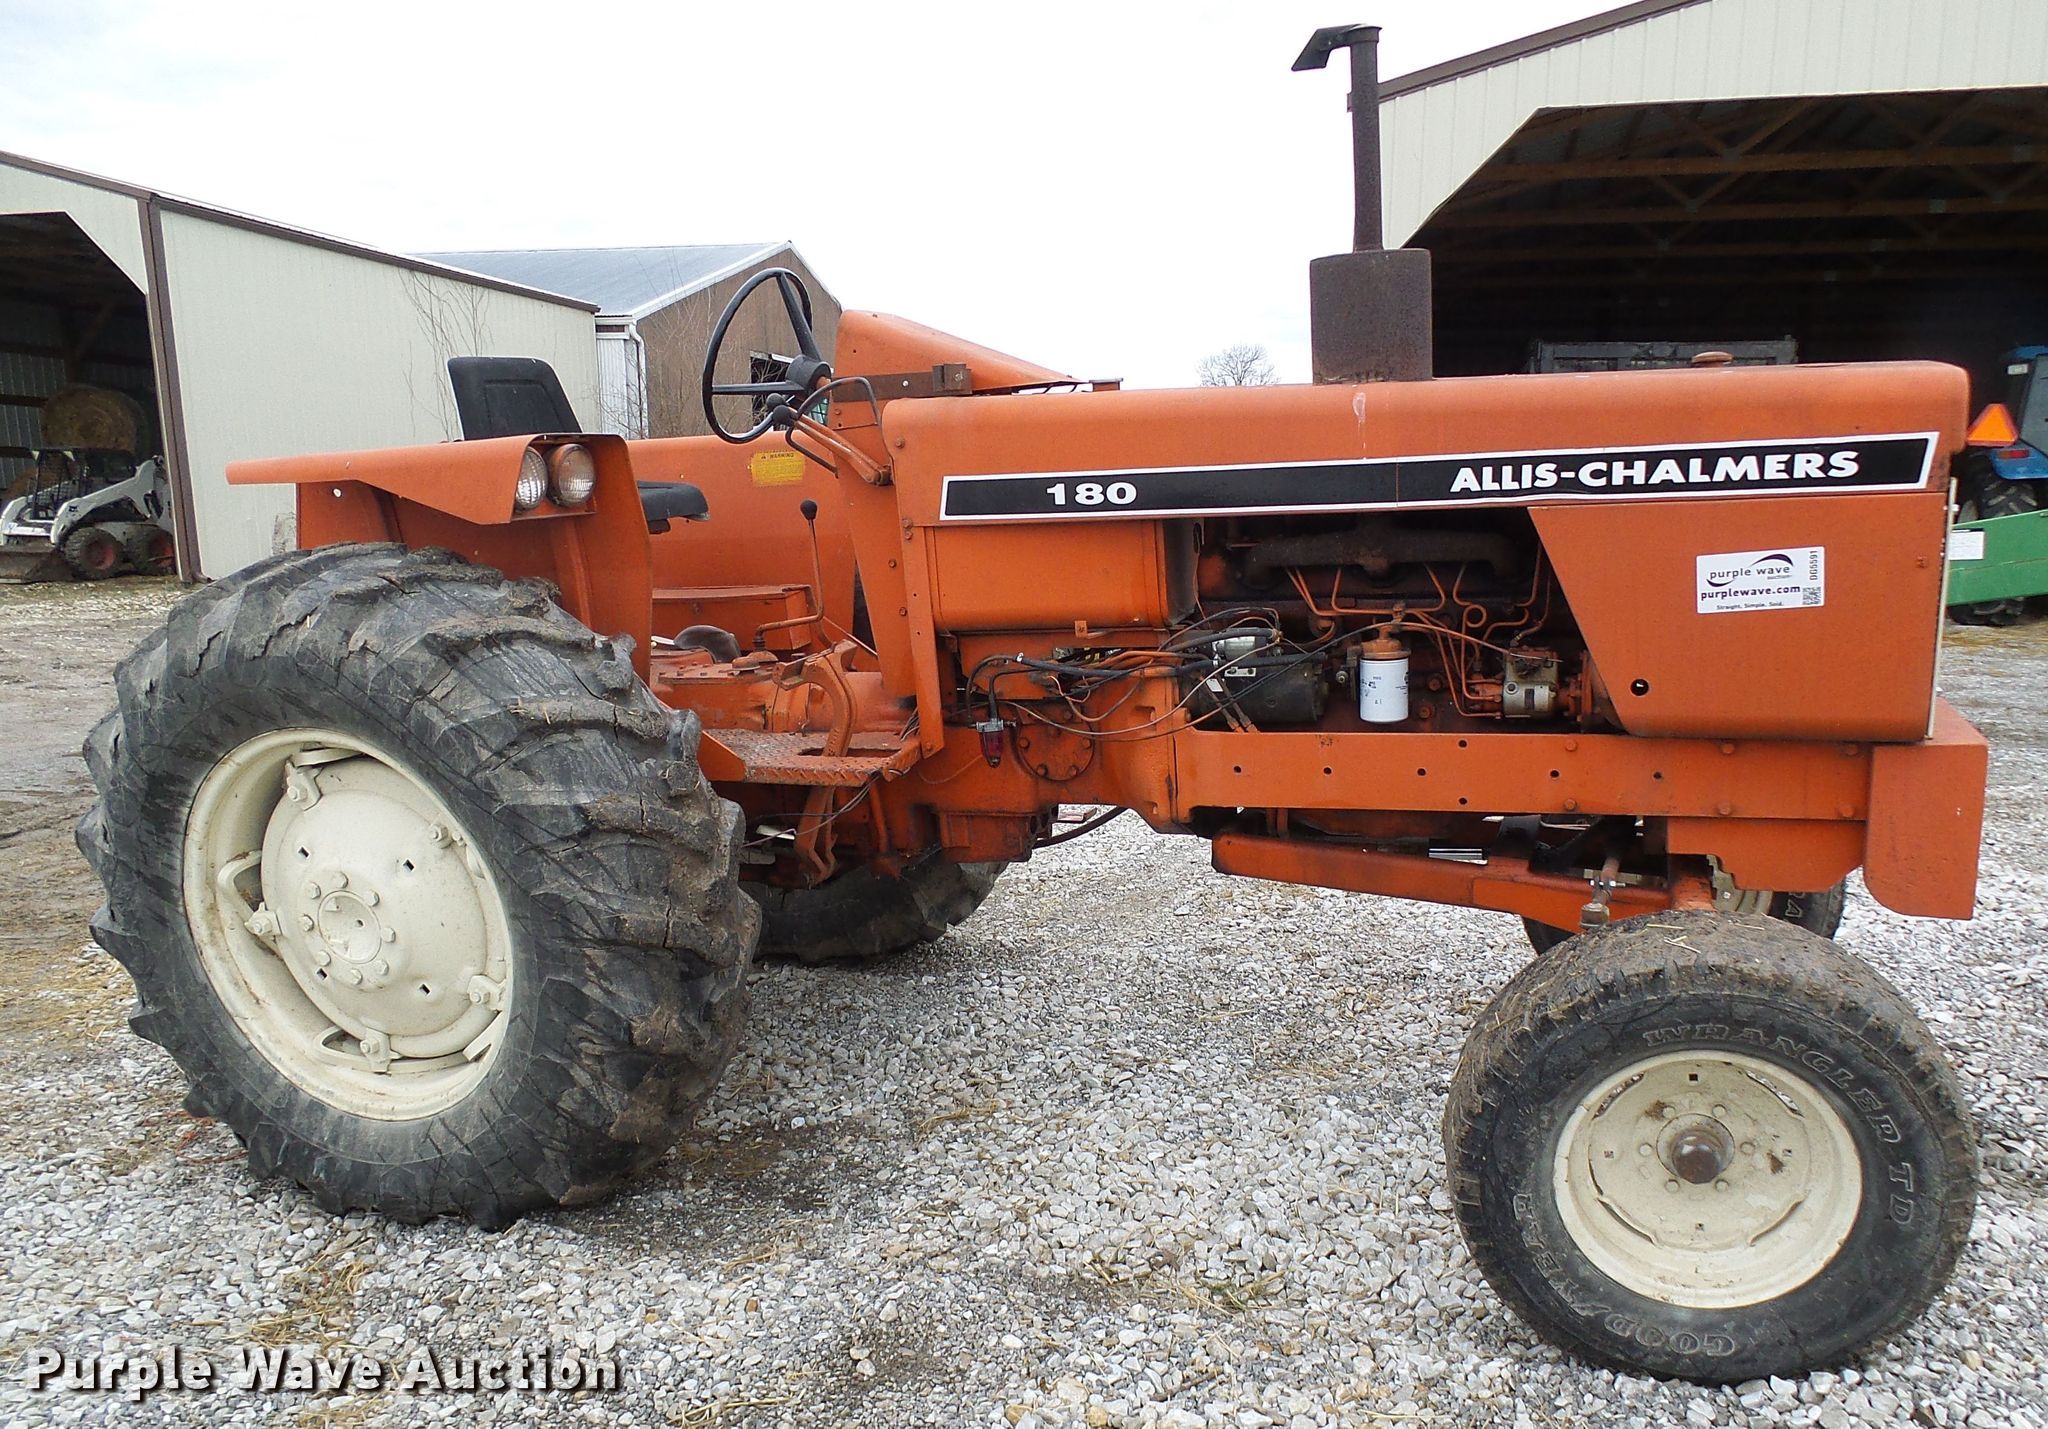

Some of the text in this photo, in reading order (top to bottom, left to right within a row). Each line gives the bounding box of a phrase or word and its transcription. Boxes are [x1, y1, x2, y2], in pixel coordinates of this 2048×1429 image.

[1449, 450, 1860, 493] ALLIS-CHALMERS
[1046, 482, 1137, 505] 180
[1710, 565, 1790, 580] purple wave
[1701, 586, 1800, 601] purplewave.com
[1642, 1024, 1901, 1144] WRANGLER
